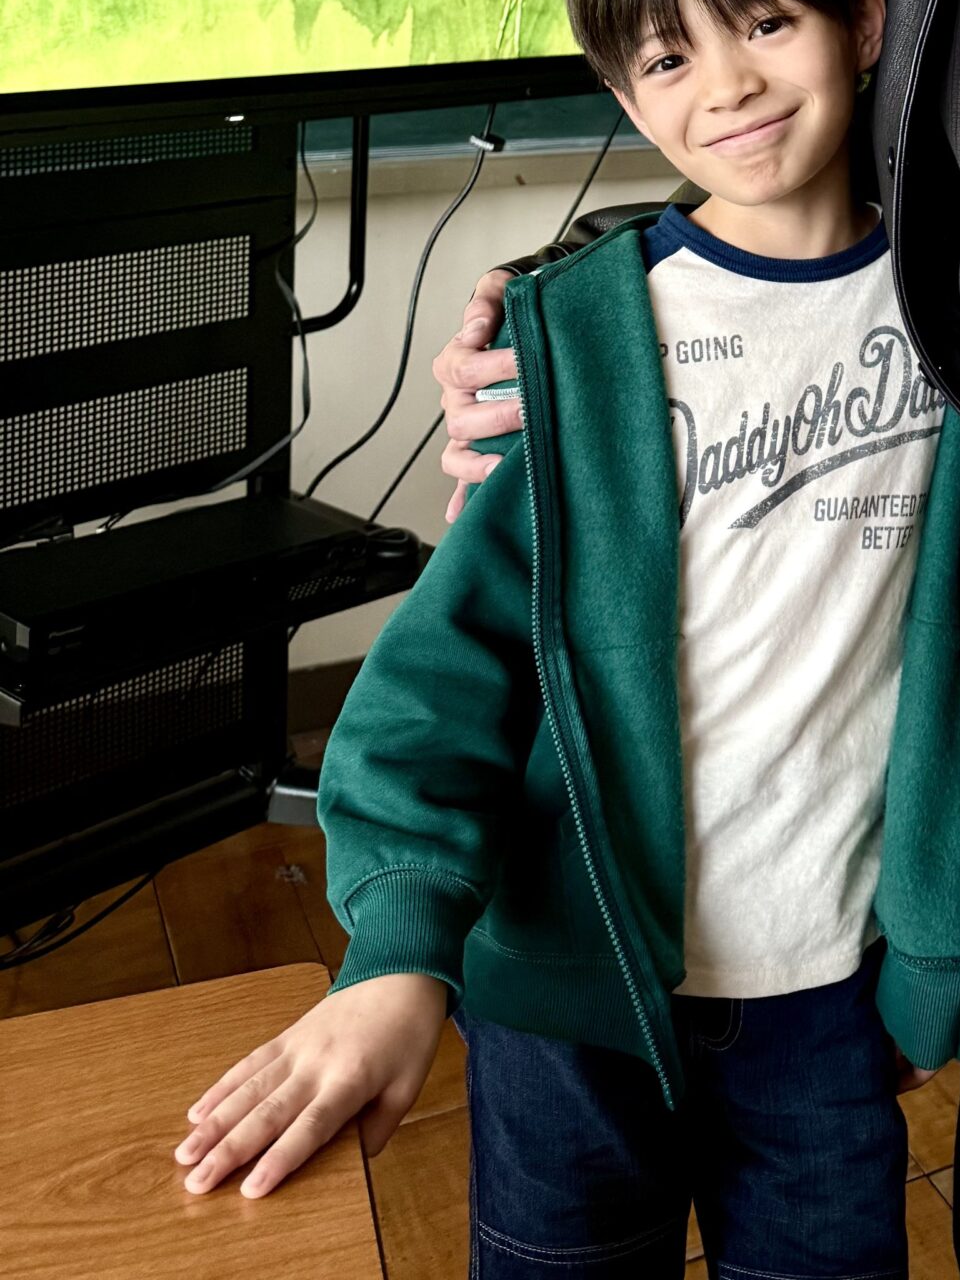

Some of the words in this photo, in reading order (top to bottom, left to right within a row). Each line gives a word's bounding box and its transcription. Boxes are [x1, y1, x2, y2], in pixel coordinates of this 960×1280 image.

[676, 334, 744, 365] GOING
[814, 494, 917, 522] GUARANTEED
[861, 525, 915, 550] BETTER
